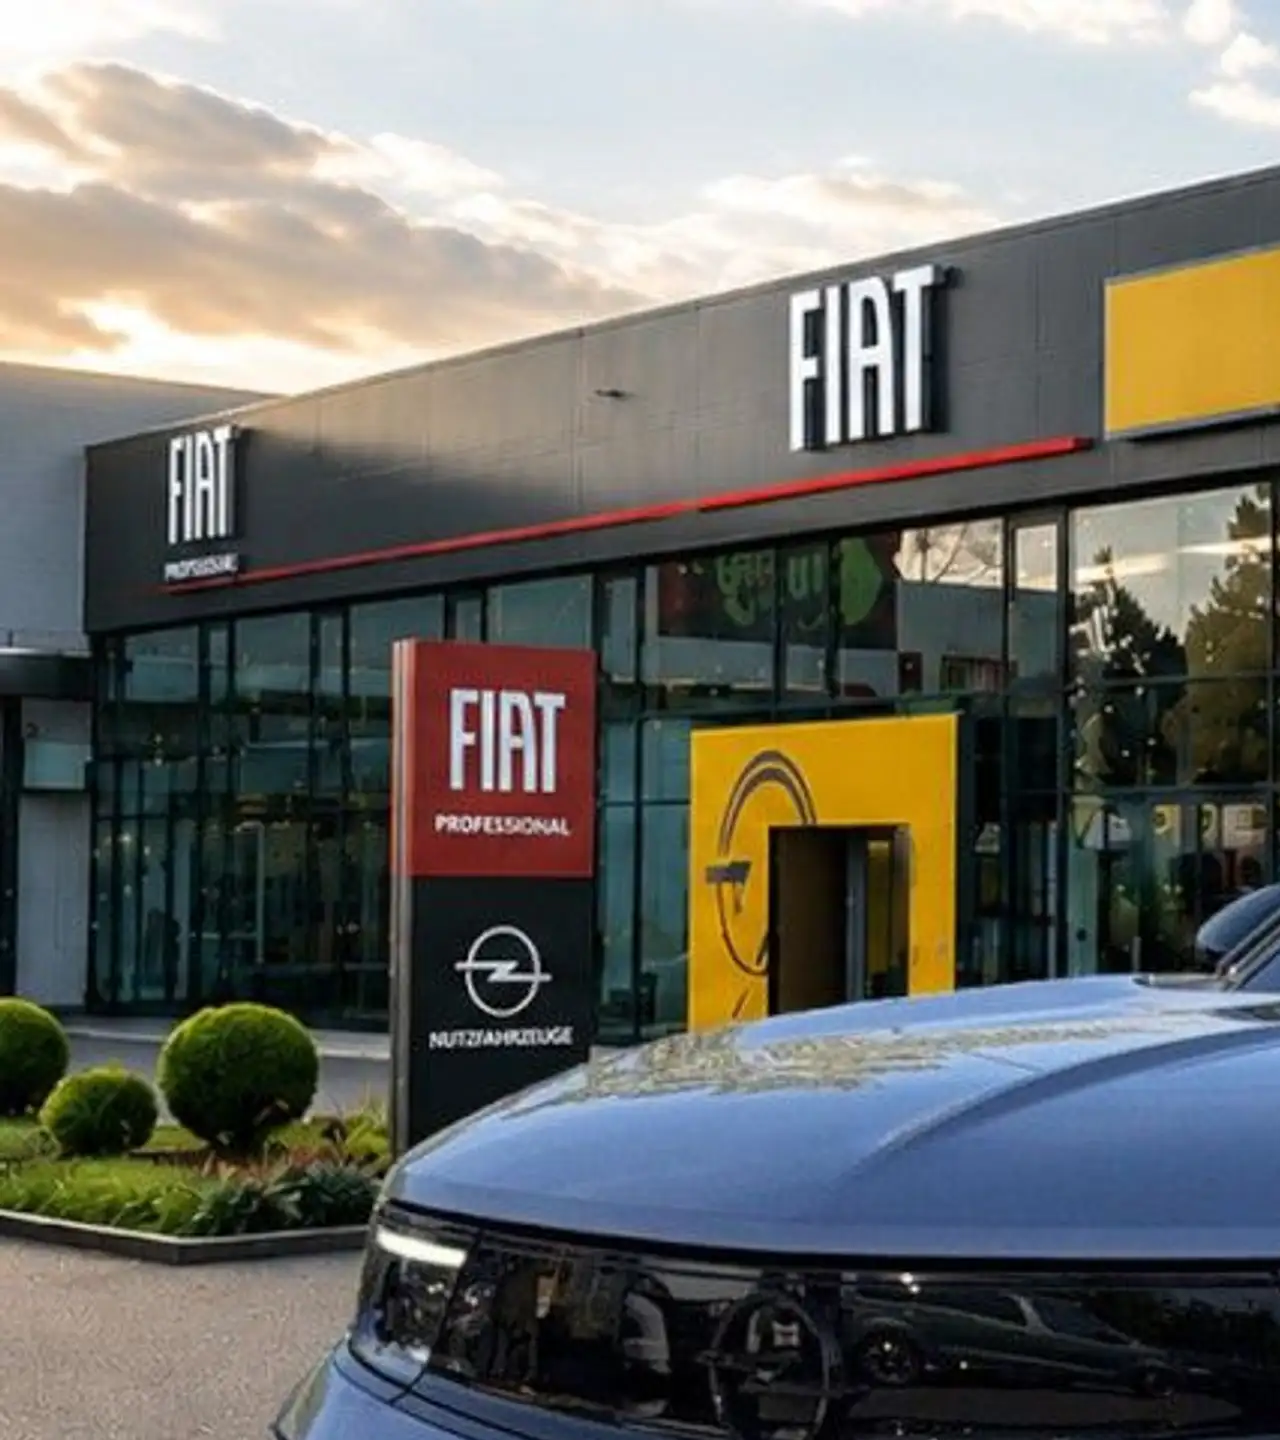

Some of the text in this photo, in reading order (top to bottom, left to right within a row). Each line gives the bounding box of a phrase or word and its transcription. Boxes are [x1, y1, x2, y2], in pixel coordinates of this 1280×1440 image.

[788, 264, 940, 452] FIAT
[168, 425, 232, 544] FIAT
[450, 688, 567, 793] FIAT
[434, 814, 571, 836] PROFESSIONAL
[428, 1026, 574, 1049] NUTZFAHRZEUGE
